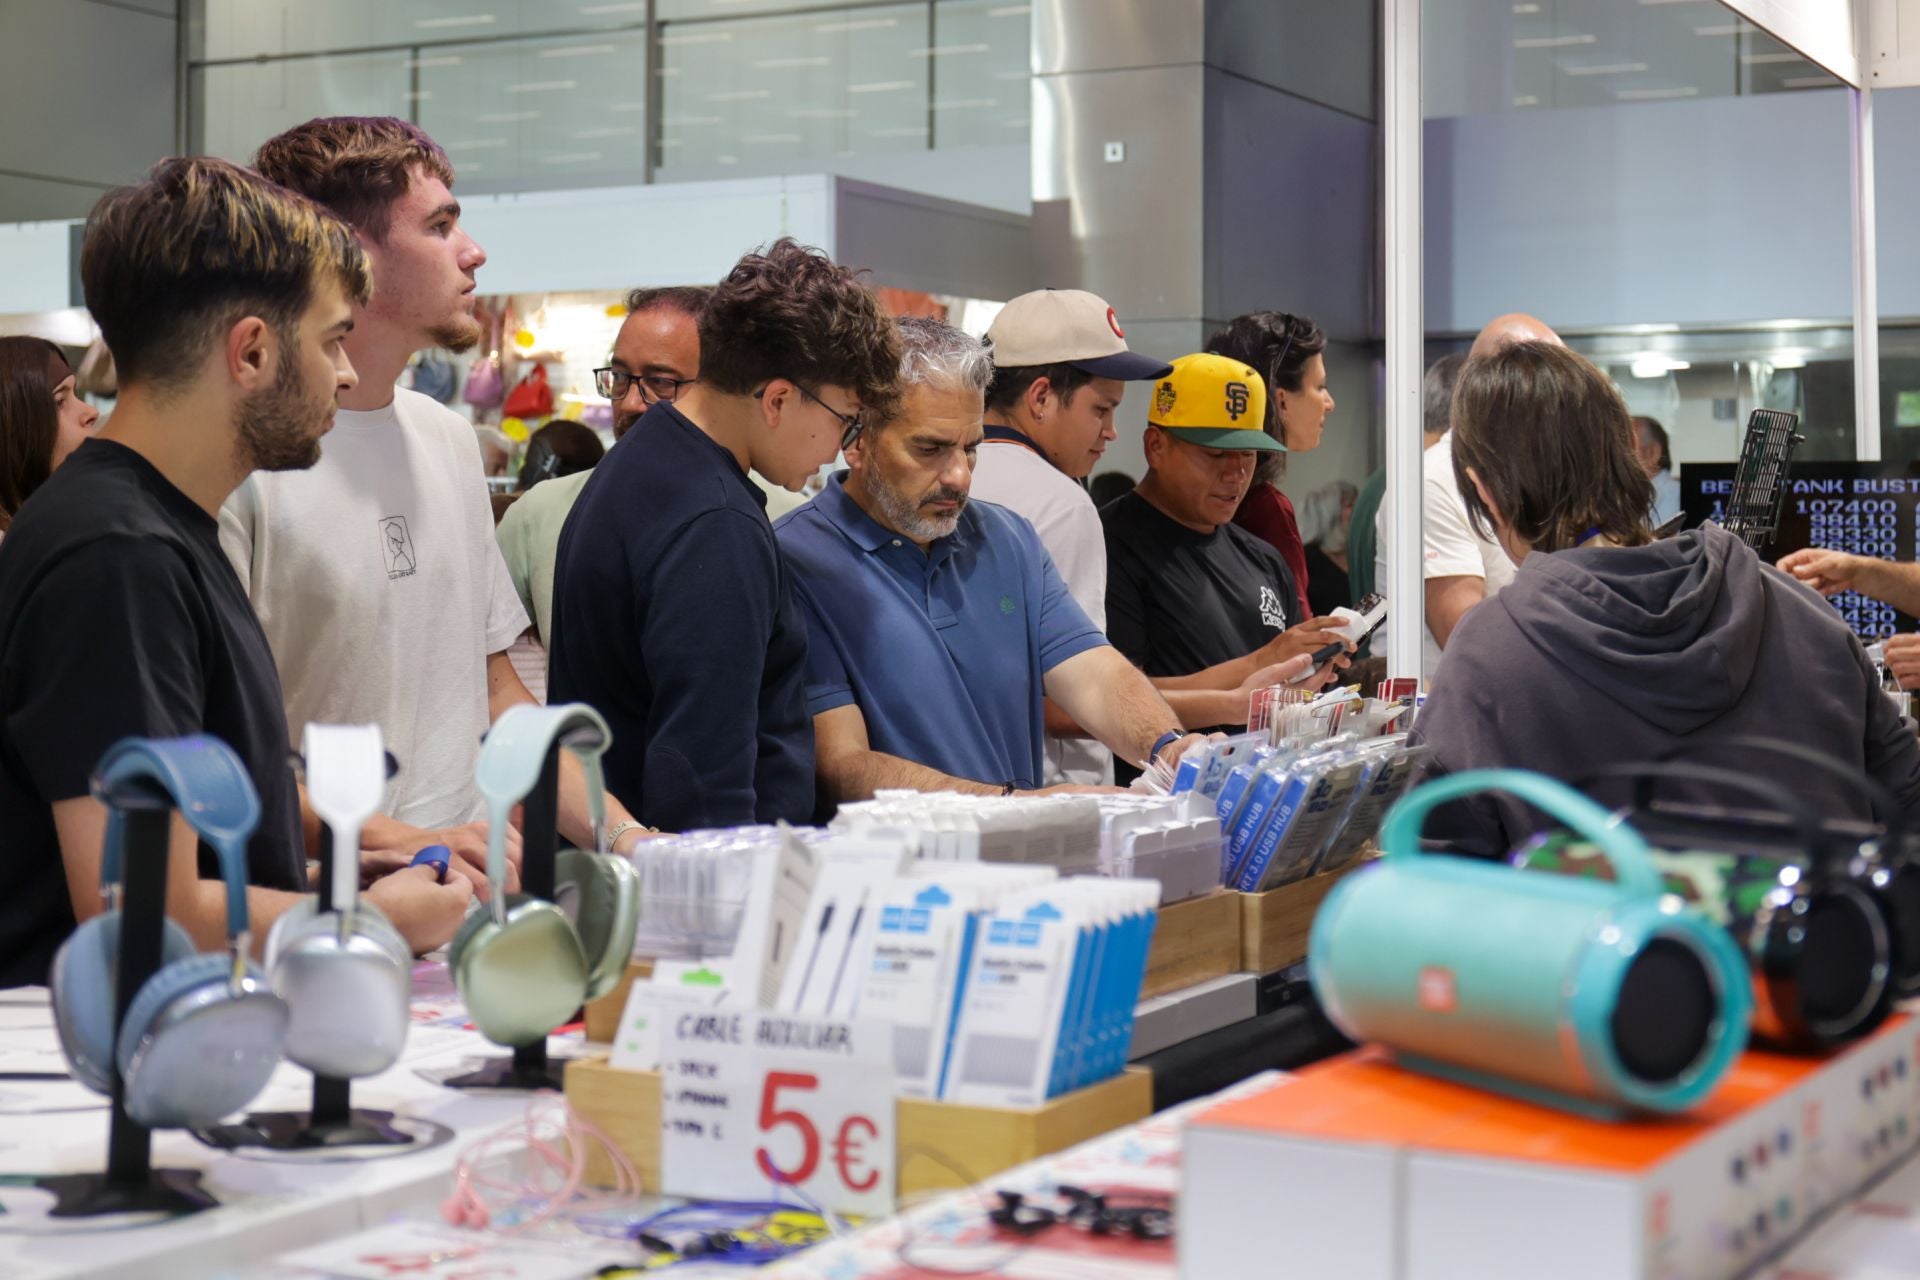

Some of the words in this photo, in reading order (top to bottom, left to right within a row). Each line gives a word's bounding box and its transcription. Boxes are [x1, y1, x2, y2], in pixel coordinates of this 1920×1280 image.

[1225, 382, 1250, 421] SF
[1796, 500, 1897, 514] 107400
[1810, 514, 1897, 527] 98410
[1810, 528, 1897, 541] 89330
[1837, 609, 1897, 623] 430
[1231, 828, 1250, 854] USB
[1245, 802, 1263, 829] HUB
[1259, 830, 1277, 855] USB
[1272, 804, 1291, 831] HUB
[676, 1014, 742, 1044] CABLE
